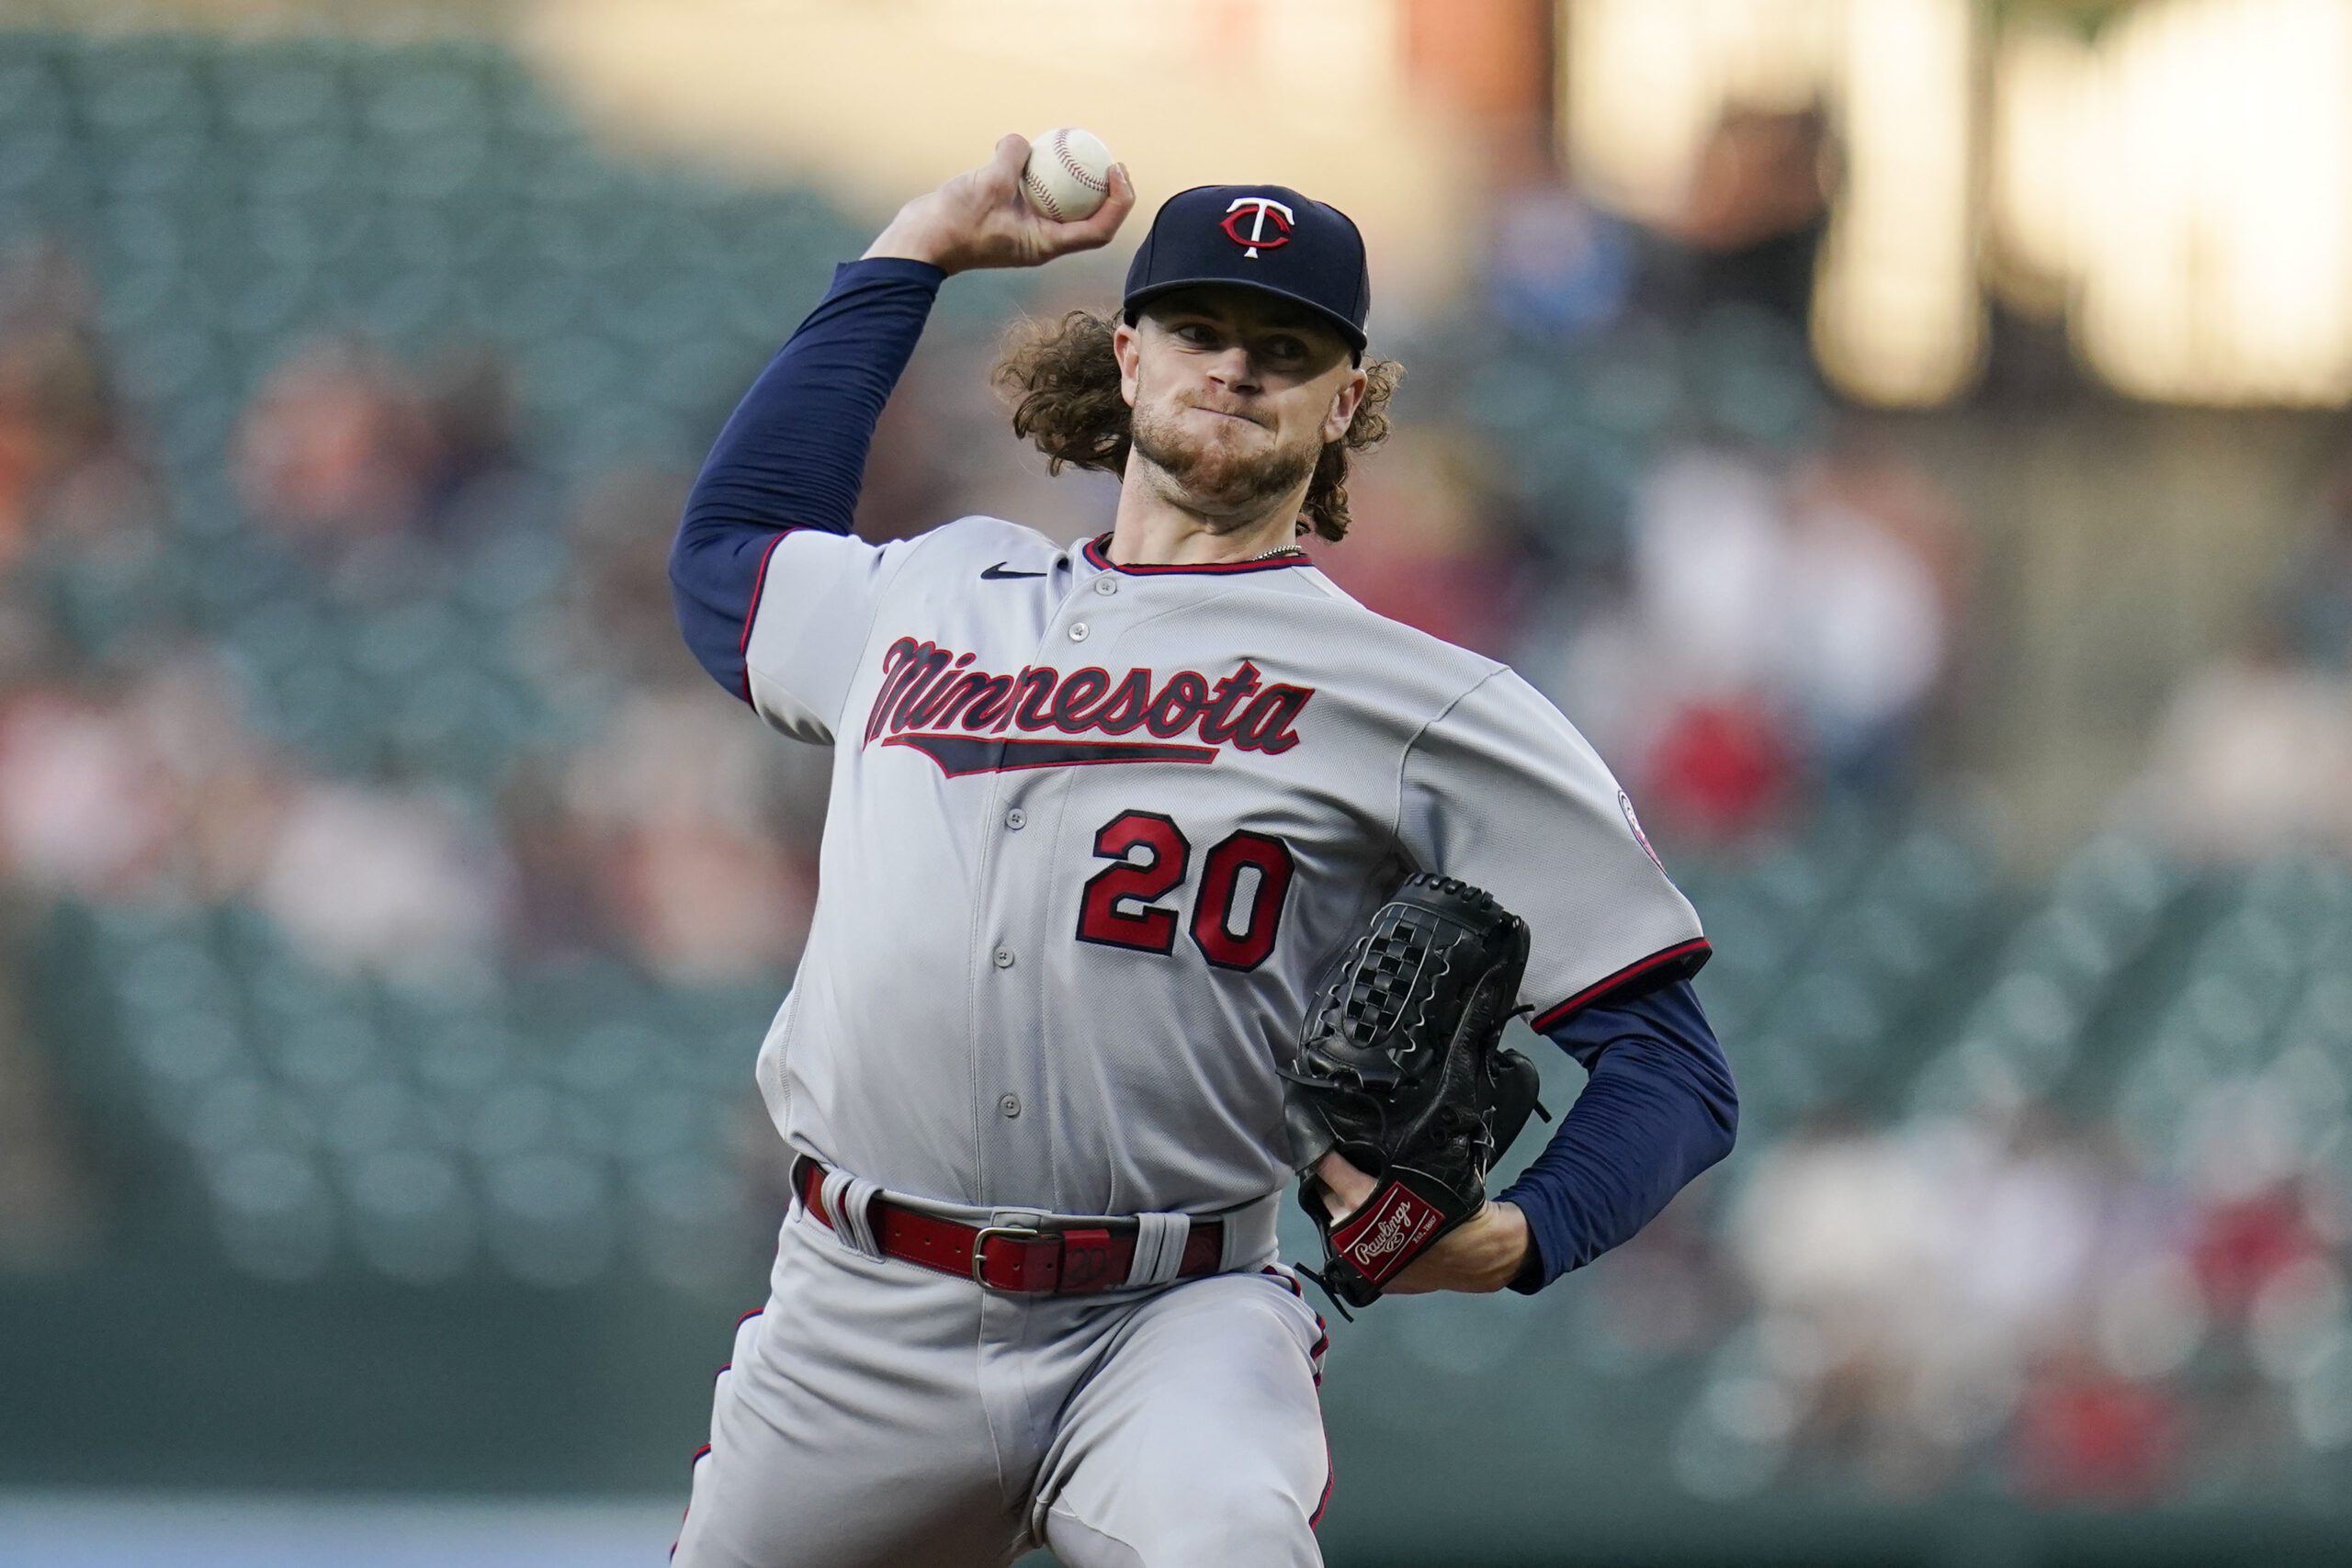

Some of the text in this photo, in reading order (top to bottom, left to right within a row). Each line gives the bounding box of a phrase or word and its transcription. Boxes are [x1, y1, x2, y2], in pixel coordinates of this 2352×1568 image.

[863, 637, 1316, 755] Minnesota
[1076, 809, 1295, 973] 20
[1355, 1201, 1411, 1265] Rawlings
